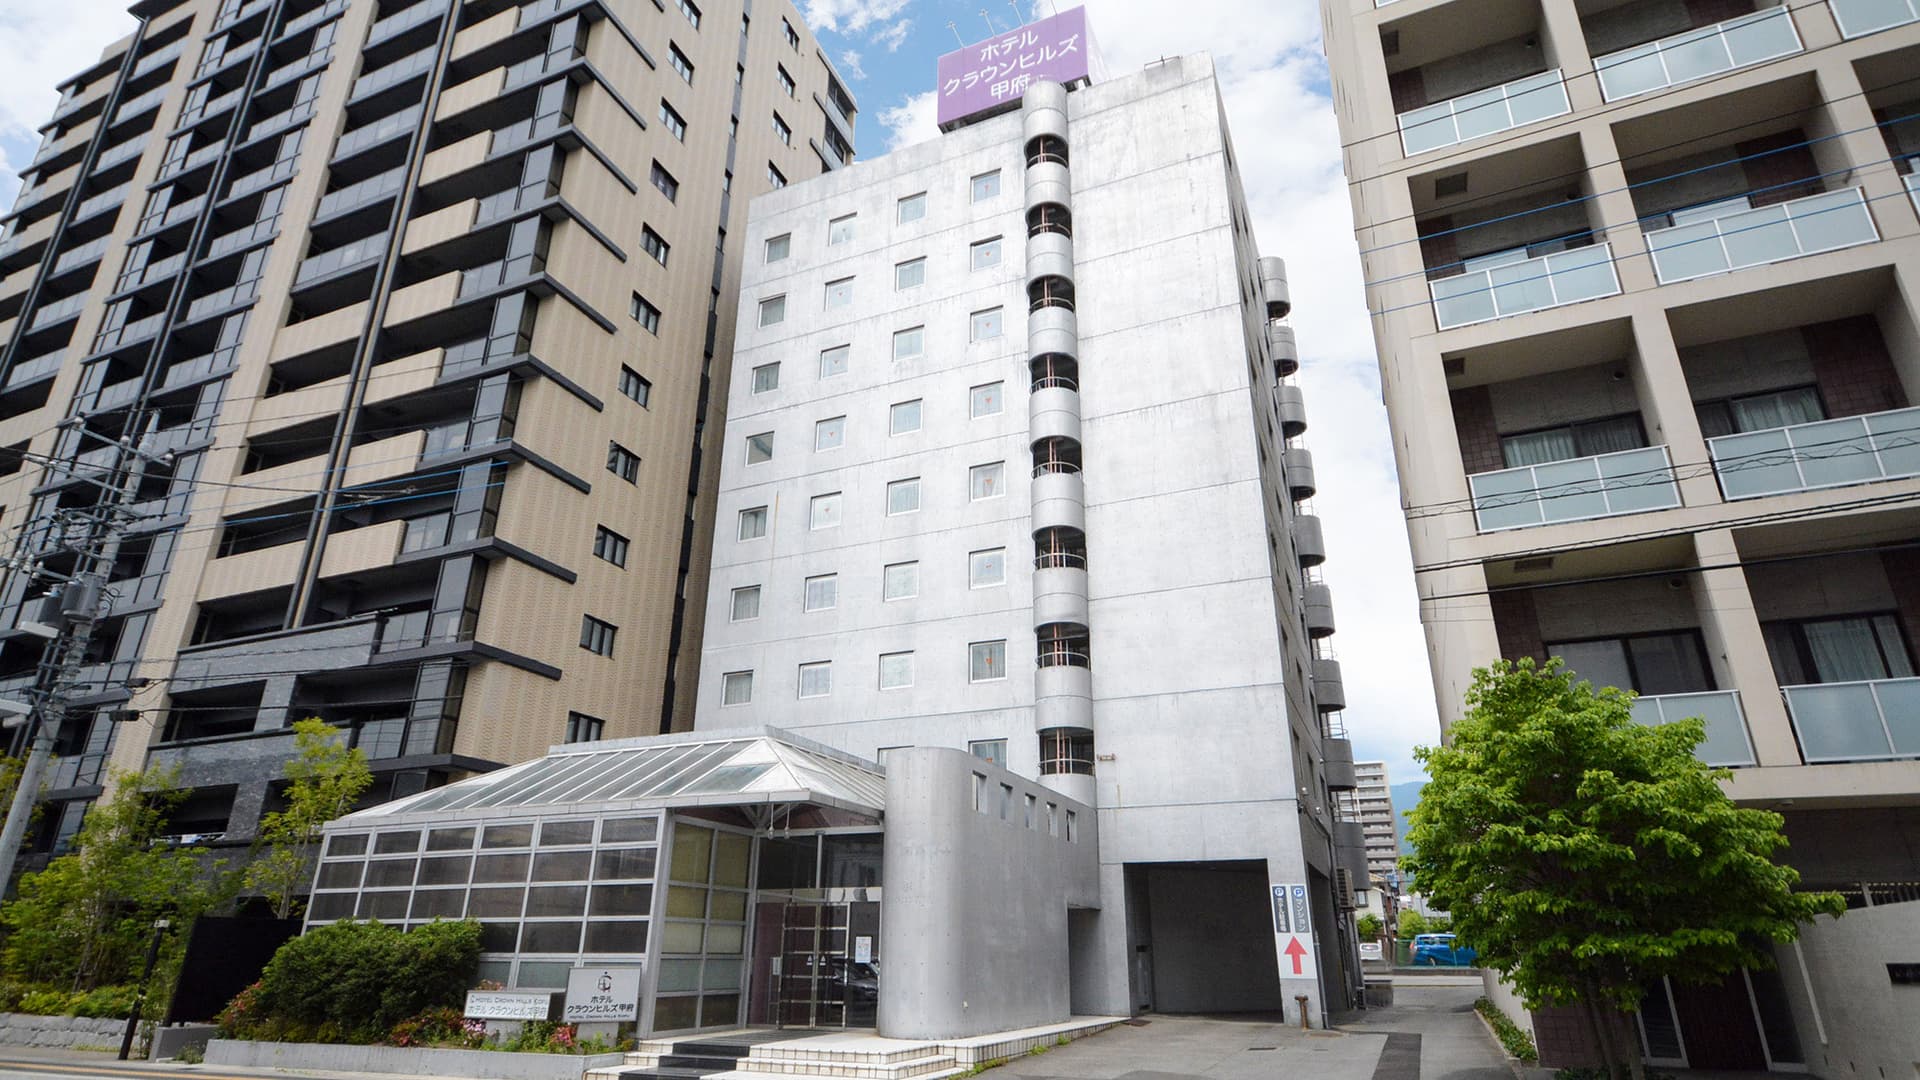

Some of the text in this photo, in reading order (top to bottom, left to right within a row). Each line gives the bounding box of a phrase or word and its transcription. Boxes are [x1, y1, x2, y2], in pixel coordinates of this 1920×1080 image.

[980, 30, 1039, 62] ホテル
[943, 33, 1080, 97] クラウンヒルズ
[990, 73, 1032, 100] 甲府
[567, 1003, 635, 1014] クラウンヒルズ甲府
[590, 995, 614, 1004] ホテル
[468, 1004, 548, 1018] ホテル クラウンヒルズ甲府
